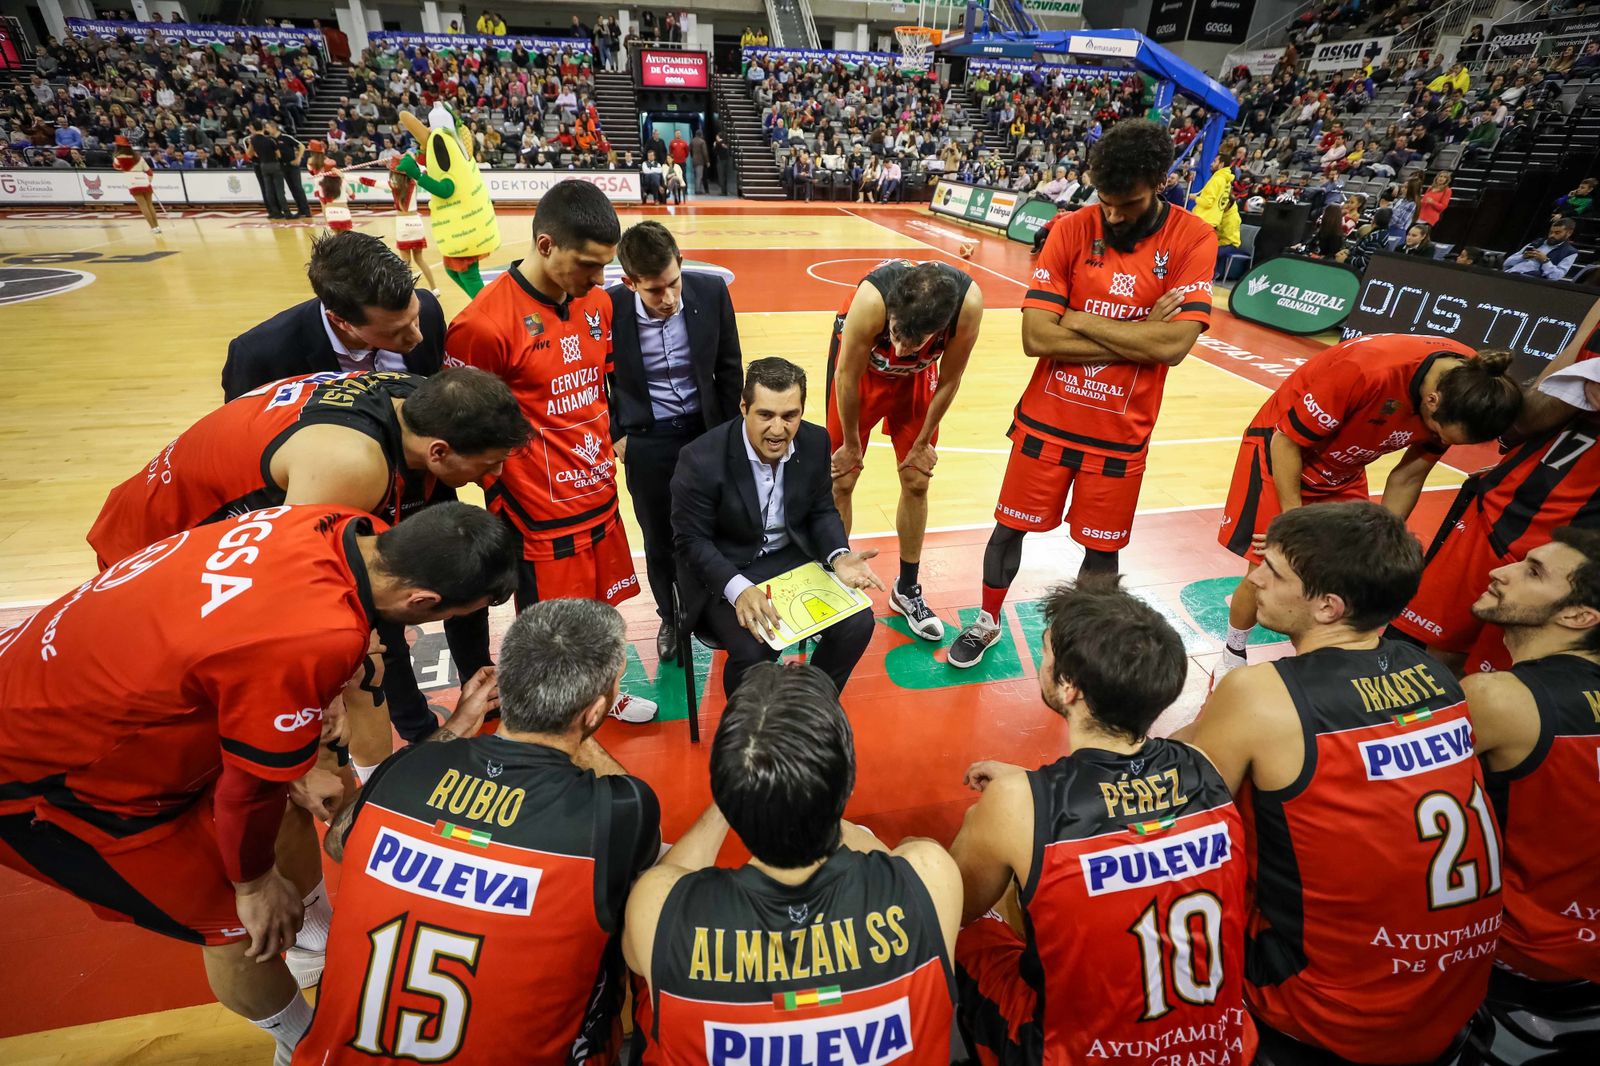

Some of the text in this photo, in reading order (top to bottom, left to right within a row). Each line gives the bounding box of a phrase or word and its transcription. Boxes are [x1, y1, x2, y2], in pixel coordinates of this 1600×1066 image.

[1023, 0, 1081, 13] COVIRAN
[122, 26, 148, 35] PULEV
[159, 28, 184, 37] ULEVA
[186, 29, 214, 37] PULEVA
[424, 36, 450, 44] PULEVA
[646, 54, 703, 65] AYUNTAMIENTO
[1093, 43, 1122, 53] emasagra
[1318, 42, 1364, 62] asisa
[650, 64, 699, 75] DE GRANADA
[491, 180, 549, 191] DEKTON
[1176, 281, 1213, 296] CASTO
[1271, 283, 1346, 311] CAJA RURAL
[1276, 297, 1320, 316] GRANADA
[1055, 370, 1124, 397] CAJA RURAL
[1064, 384, 1107, 401] GRANADA
[1303, 392, 1340, 430] CASTOR
[1540, 430, 1596, 471] 17
[555, 468, 587, 483] CAJA
[1003, 507, 1042, 523] BERNER
[1081, 526, 1121, 540] asisa
[606, 573, 637, 600] asisa
[1365, 723, 1474, 777] PULEVA
[426, 768, 527, 828] RUBIO
[1098, 768, 1188, 819] PÉREZ
[1413, 776, 1502, 912] 21
[369, 833, 529, 910] PULEVA
[1087, 832, 1229, 892] PULEVA
[688, 904, 910, 983] ALMAZÁN SS
[1126, 888, 1224, 1023] 10
[1391, 958, 1426, 975] DE
[346, 911, 486, 1065] 15
[712, 1013, 908, 1066] PULEVA
